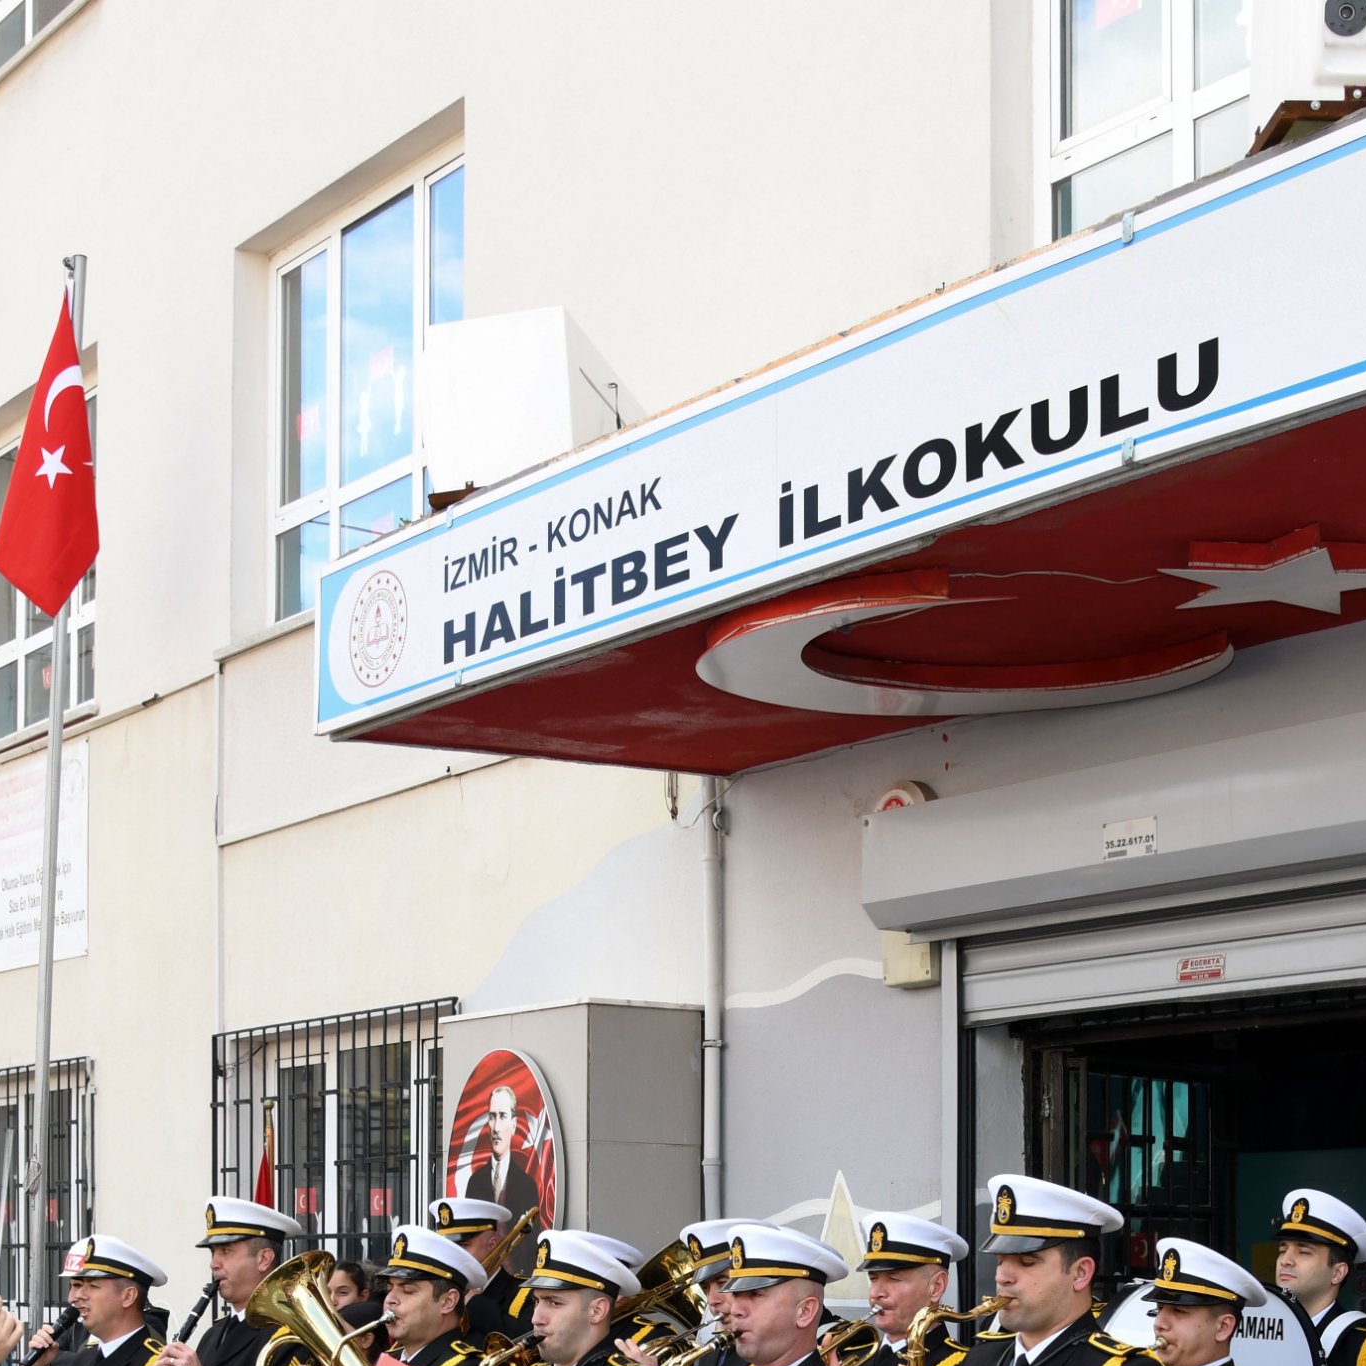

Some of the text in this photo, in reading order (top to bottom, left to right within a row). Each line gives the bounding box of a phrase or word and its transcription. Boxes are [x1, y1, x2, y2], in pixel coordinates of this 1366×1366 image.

[444, 513, 739, 665] HALİTBEY
[779, 336, 1219, 549] İLKOKULU
[444, 536, 519, 593] İZMİR
[547, 477, 662, 553] KONAK
[1105, 834, 1154, 849] 35.22.617.01
[1235, 1316, 1283, 1341] AMAHA
